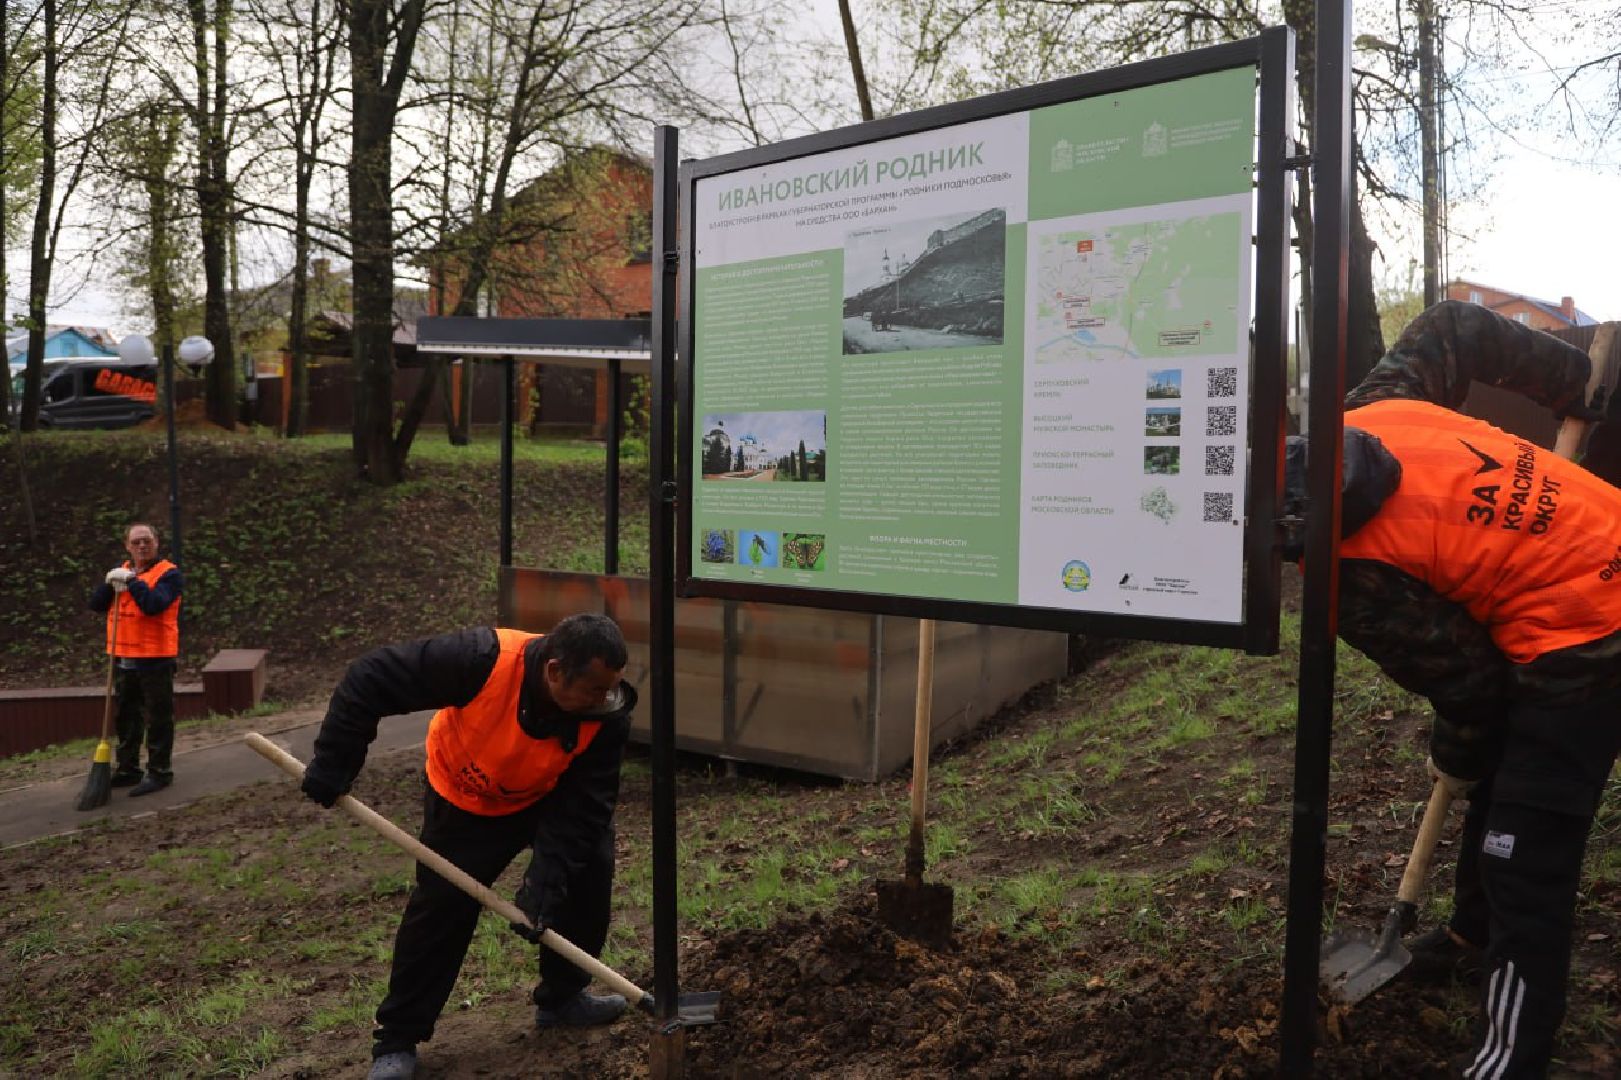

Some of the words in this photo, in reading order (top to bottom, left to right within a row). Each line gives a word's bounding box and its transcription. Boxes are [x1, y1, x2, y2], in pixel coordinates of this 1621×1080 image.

[719, 159, 869, 211] ИВАНОВСКИЙ
[876, 141, 984, 183] РОДНИК
[851, 190, 898, 206] ПРОГРАММЫ
[842, 211, 860, 221] ООО
[1466, 485, 1500, 526] ЗА
[1502, 442, 1536, 531] КРАСИВЫЙ
[1529, 476, 1561, 535] ОКРУГ
